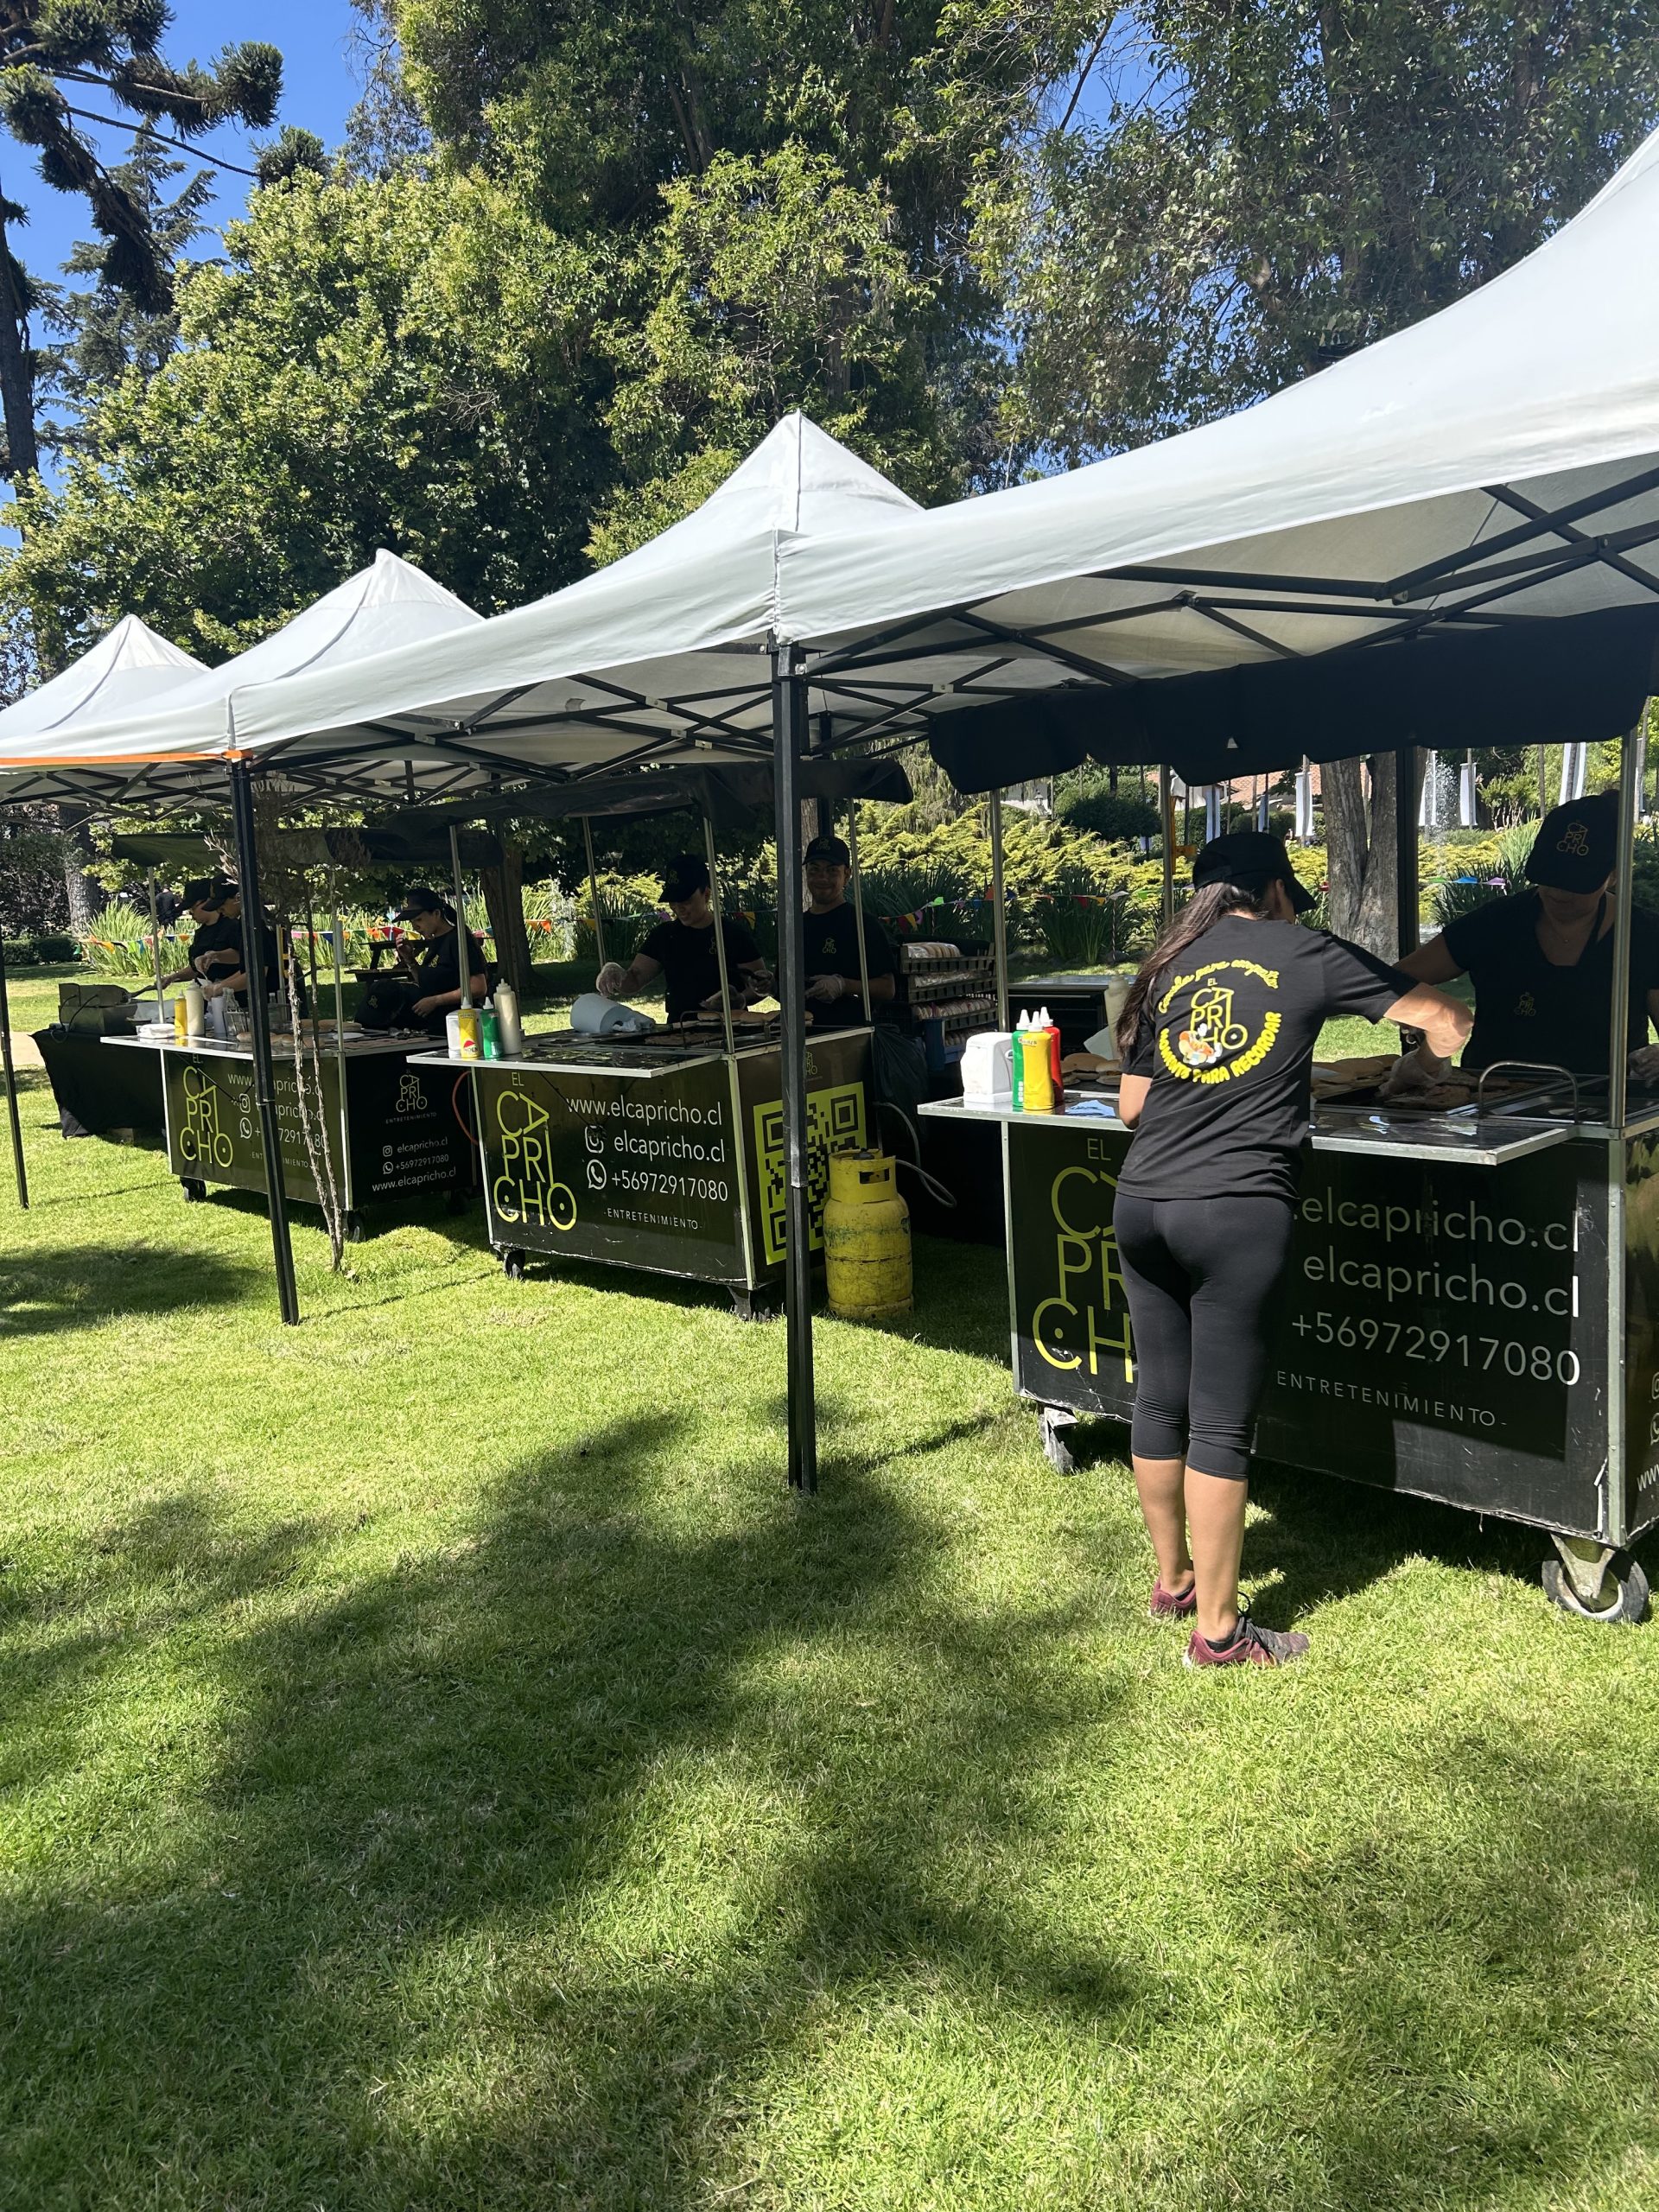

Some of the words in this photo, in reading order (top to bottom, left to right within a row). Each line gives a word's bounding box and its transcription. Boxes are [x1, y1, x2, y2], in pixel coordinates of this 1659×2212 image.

[1207, 977, 1218, 987] EL
[1192, 1065, 1230, 1084] PARA
[1230, 1011, 1282, 1077] RECORDAR
[511, 1071, 524, 1086] EL
[396, 1096, 428, 1113] CHO
[566, 1094, 722, 1126] www.elcapricho.cl
[397, 1136, 448, 1154] elcapricho.cl
[613, 1129, 725, 1163] elcapricho.cl
[1087, 1138, 1111, 1160] EL
[395, 1154, 449, 1170] +56972917080
[372, 1166, 456, 1192] www.elcapricho.cl
[611, 1169, 728, 1202] +56972917080
[493, 1176, 577, 1231] CHO
[1293, 1187, 1579, 1253] .elcapricho.cl
[1303, 1245, 1579, 1318] elcapricho.cl
[1033, 1297, 1134, 1383] CH
[1292, 1312, 1581, 1386] +56972917080
